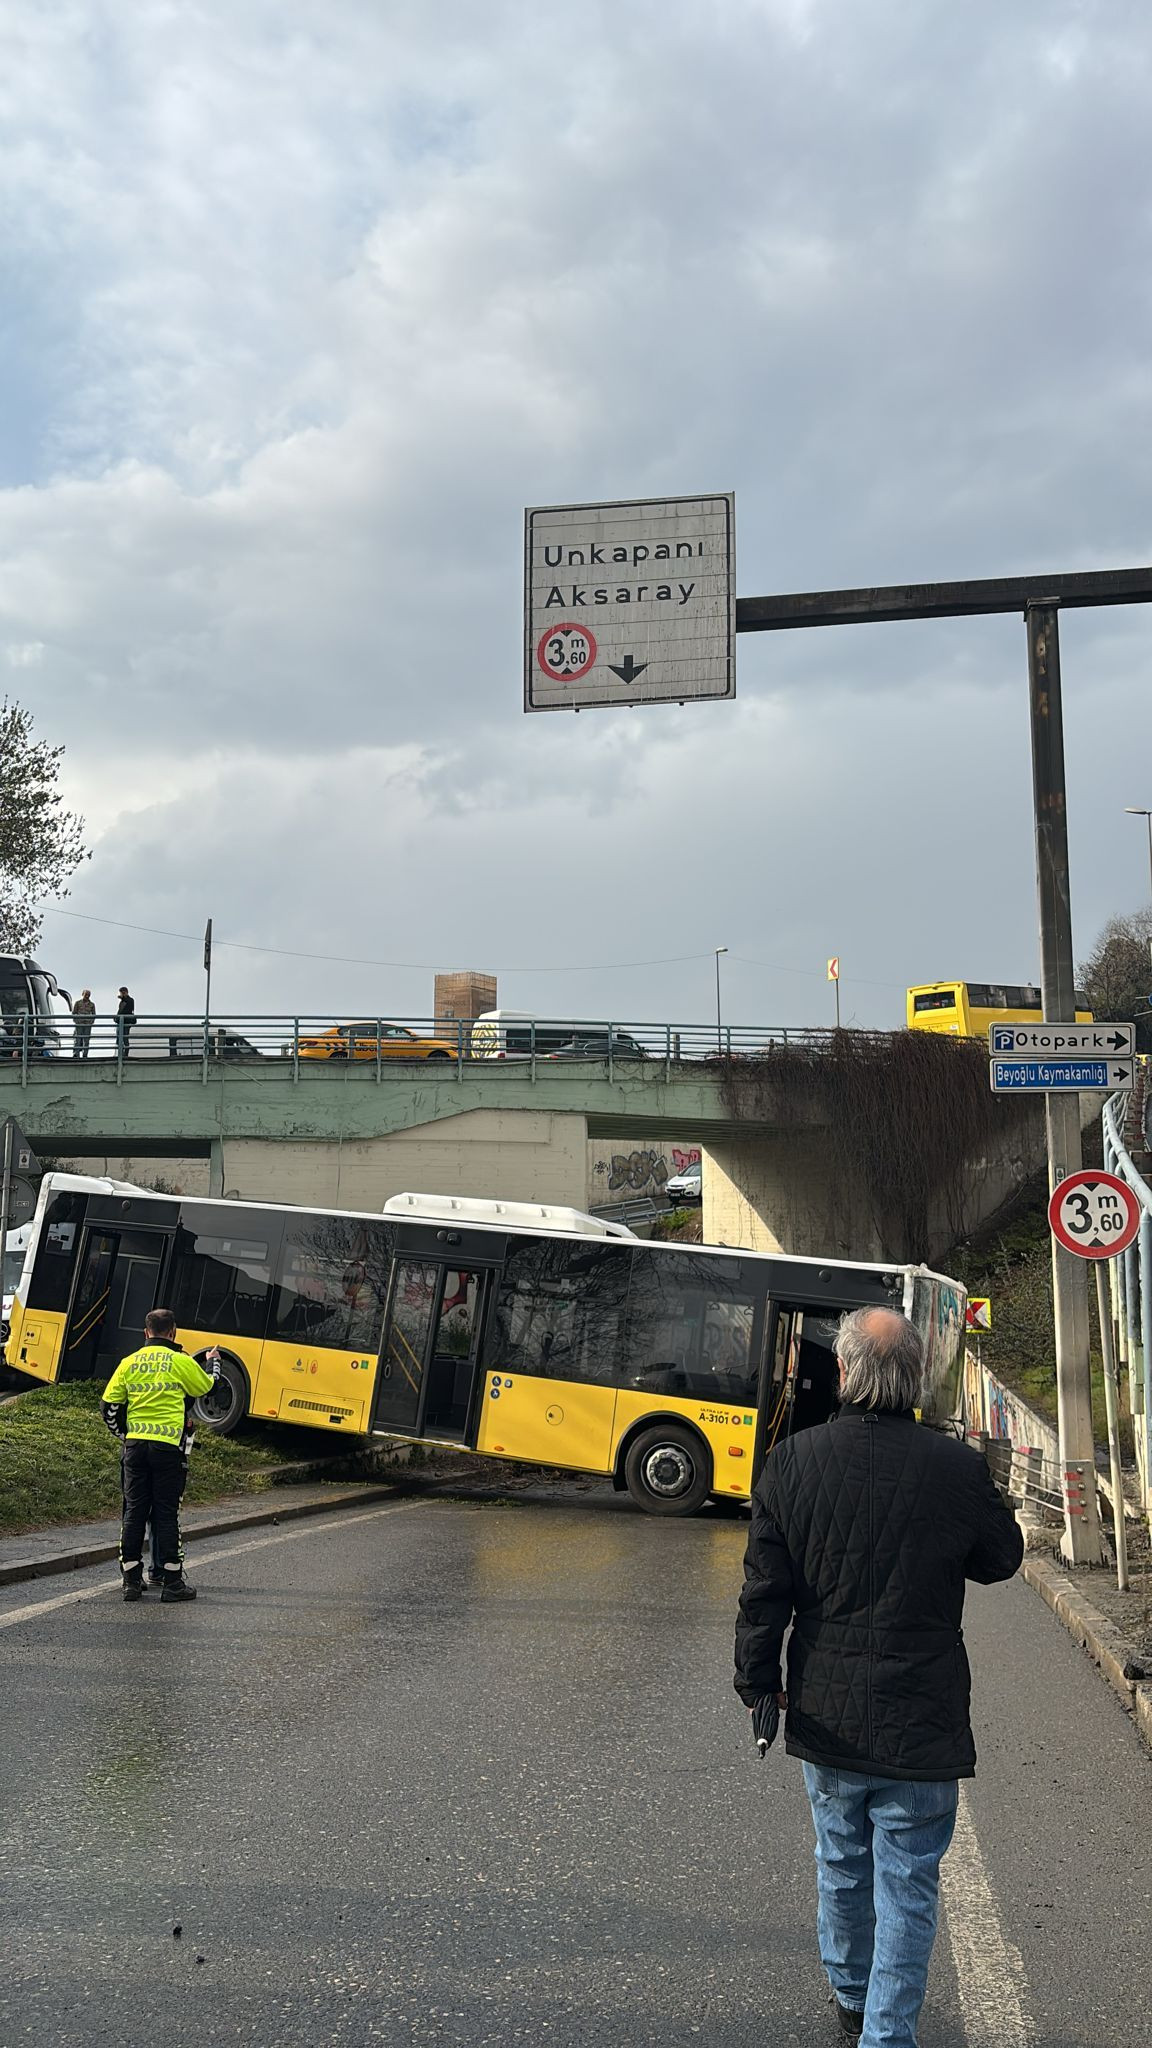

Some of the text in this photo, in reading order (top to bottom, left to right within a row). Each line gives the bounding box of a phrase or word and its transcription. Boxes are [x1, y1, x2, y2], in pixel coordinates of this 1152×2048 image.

[544, 542, 704, 567] Unkapanı
[545, 583, 695, 608] Aksaray
[1015, 1032, 1104, 1050] Otopark
[997, 1064, 1106, 1085] Beyoğlu Kaymakamlığı
[1097, 1195, 1118, 1208] m
[699, 1412, 728, 1424] A-3101
